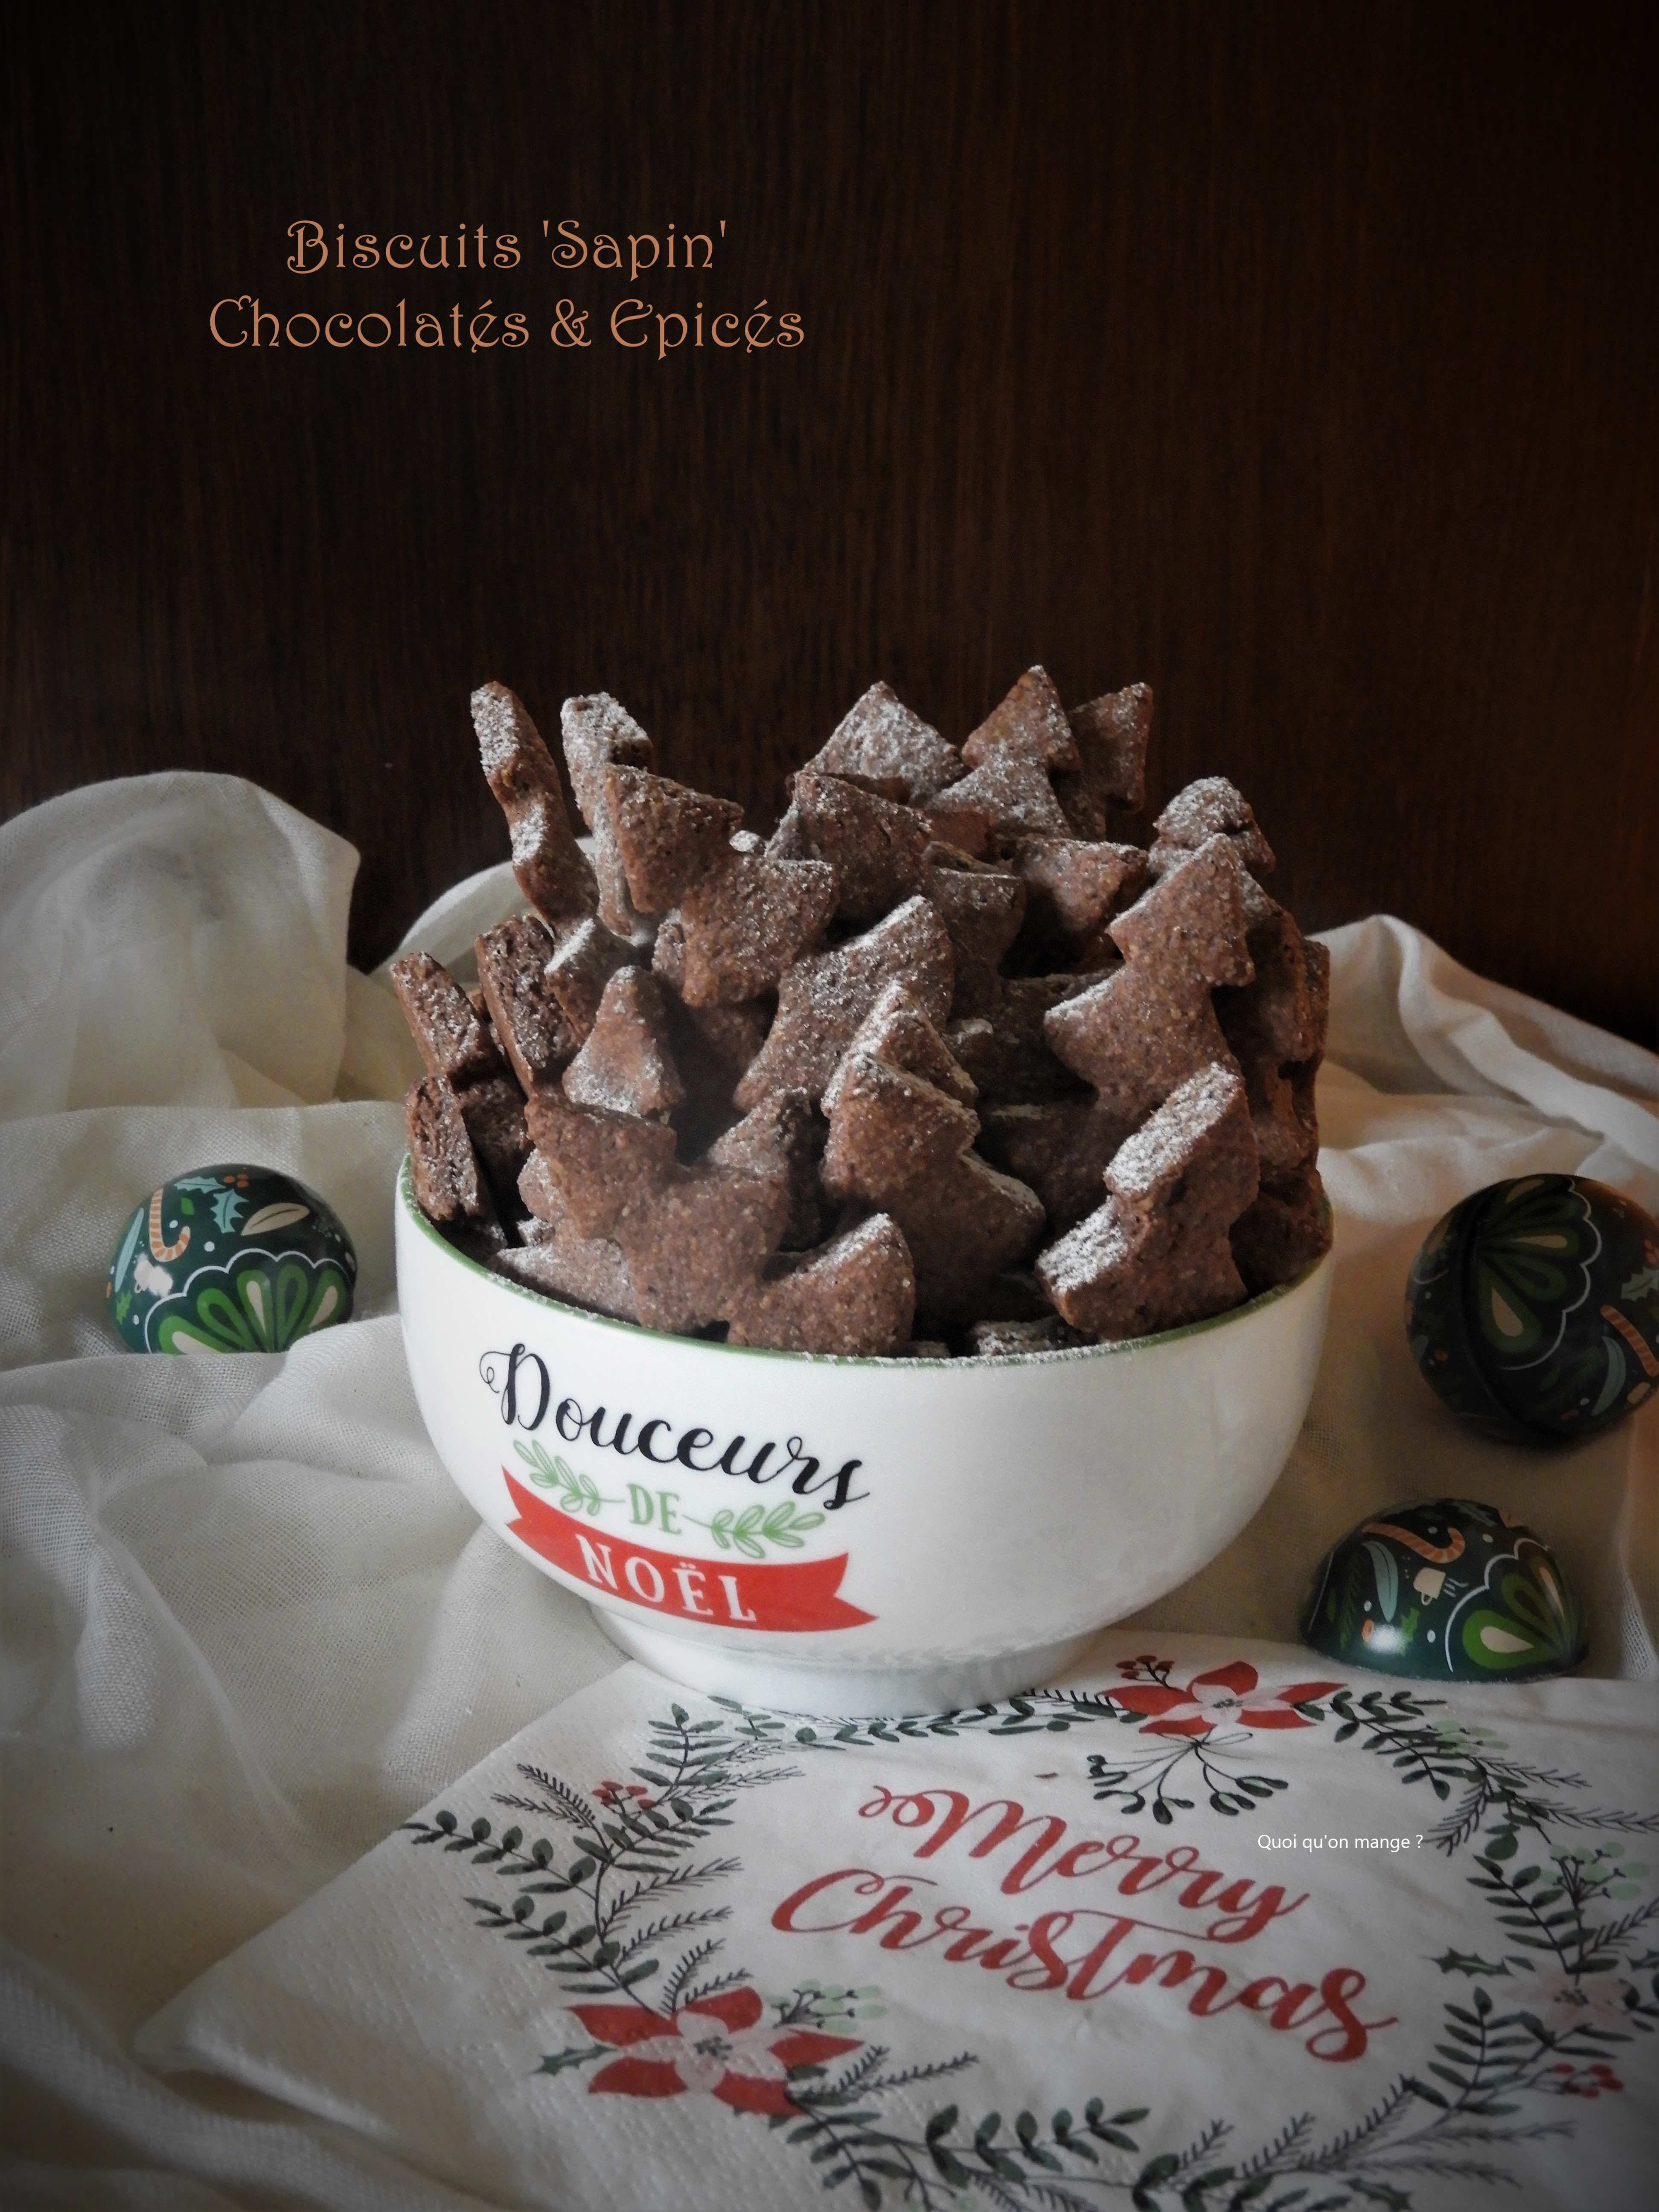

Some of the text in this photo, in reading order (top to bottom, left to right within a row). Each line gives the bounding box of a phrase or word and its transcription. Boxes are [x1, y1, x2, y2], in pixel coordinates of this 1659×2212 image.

[479, 1343, 870, 1510] Douceurs
[575, 1534, 757, 1623] NOËL
[626, 1482, 683, 1535] DE
[858, 1785, 1310, 1944] Merry
[771, 1869, 1398, 2063] Christmas
